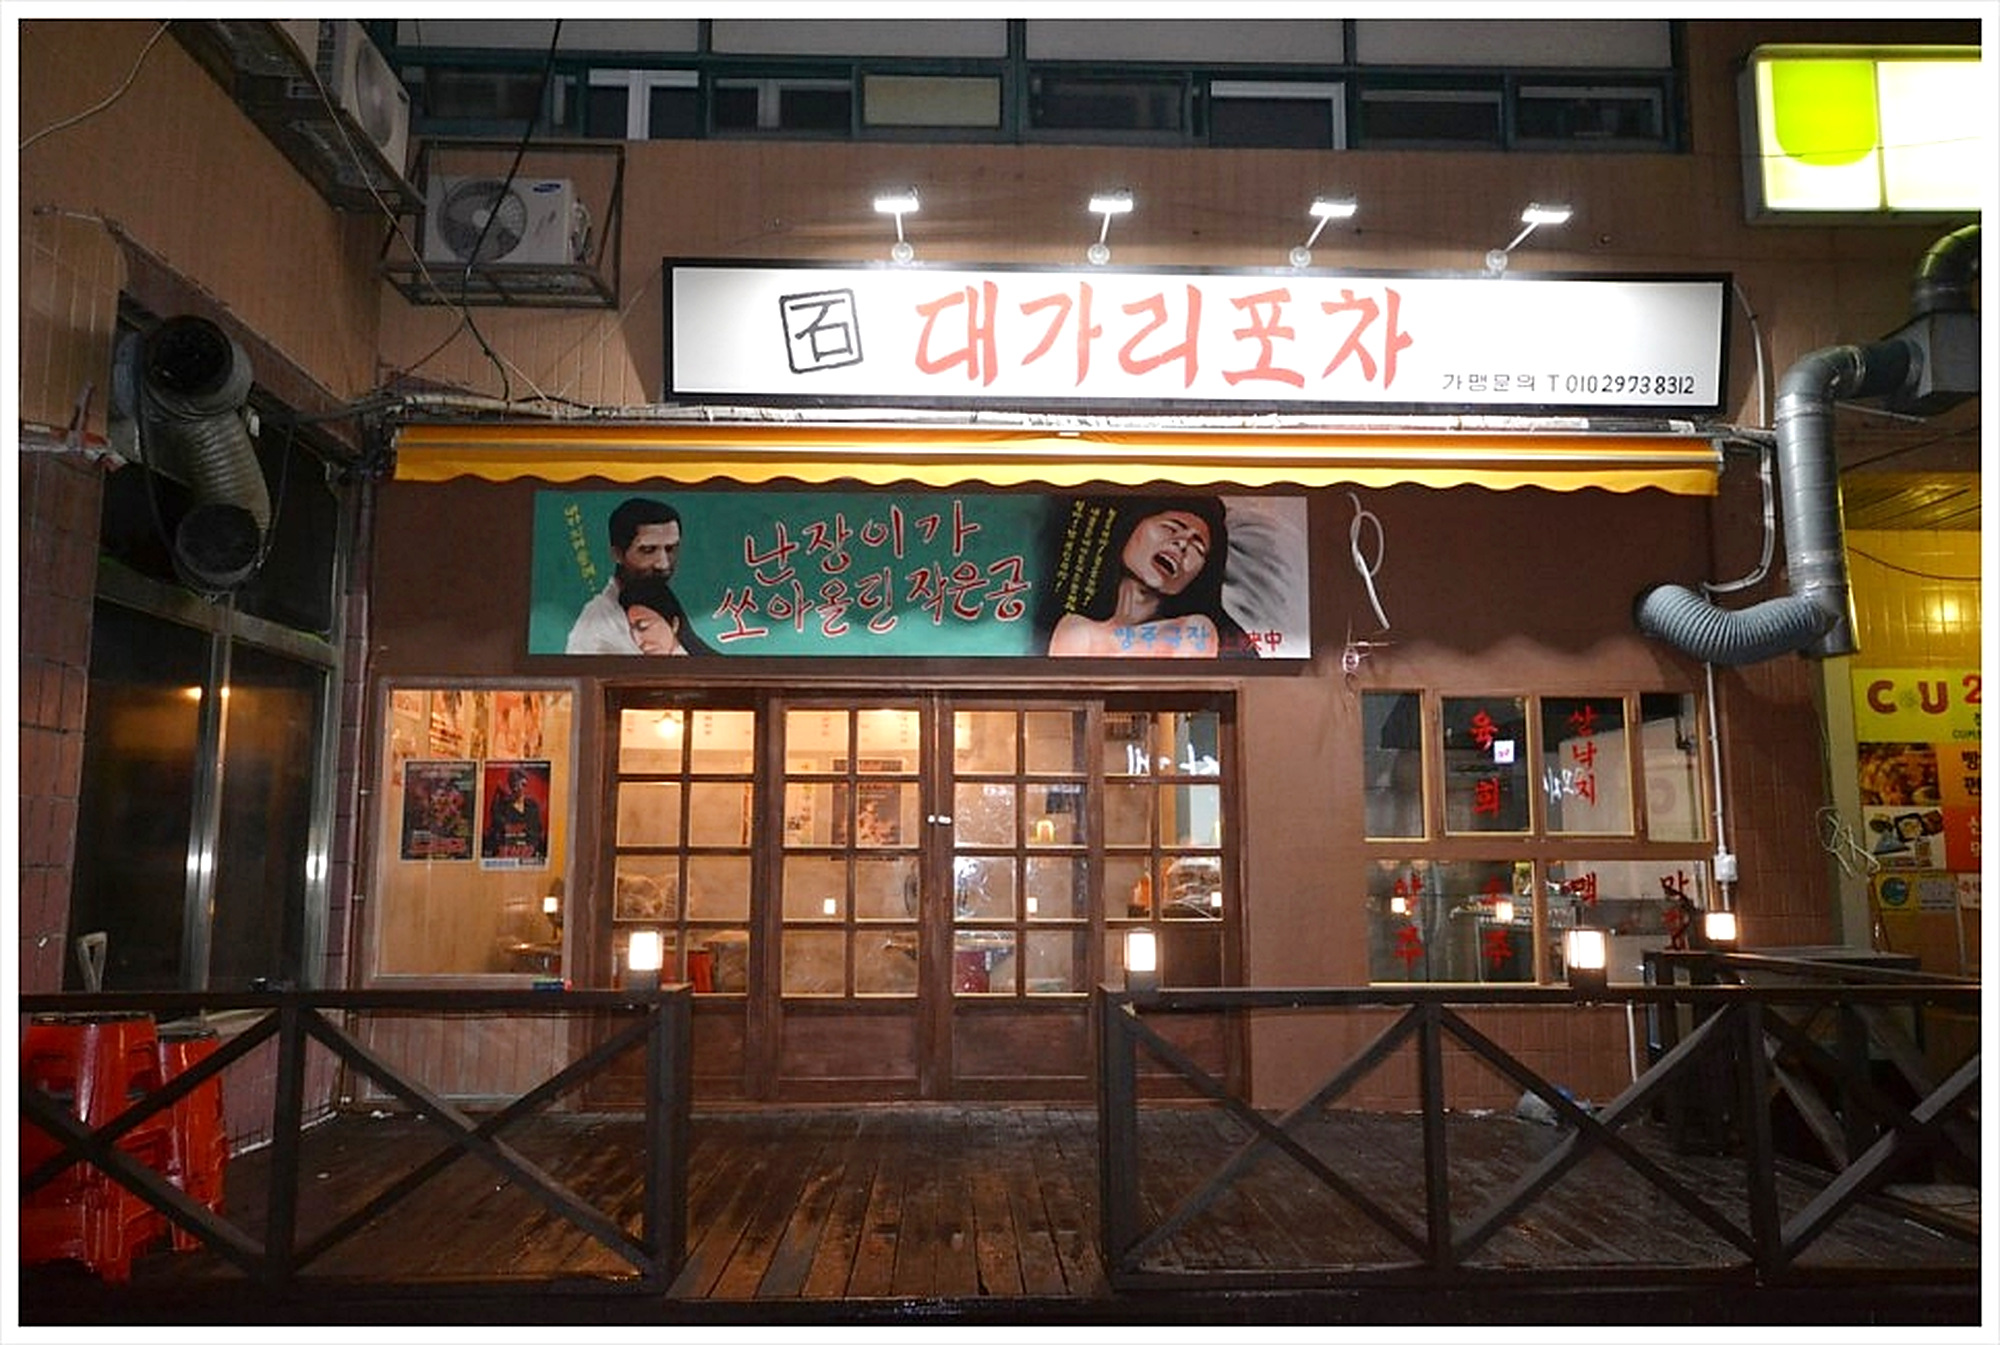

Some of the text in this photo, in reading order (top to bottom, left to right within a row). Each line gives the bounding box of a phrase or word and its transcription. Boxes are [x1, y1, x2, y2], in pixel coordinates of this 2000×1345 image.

[915, 280, 1413, 390] 대가리포차
[1442, 374, 1535, 392] 가맹문의
[744, 499, 981, 585] 난장이가
[712, 566, 898, 643] 쏘아올린
[1469, 709, 1500, 817] 육회
[1570, 704, 1598, 808] 산낙지
